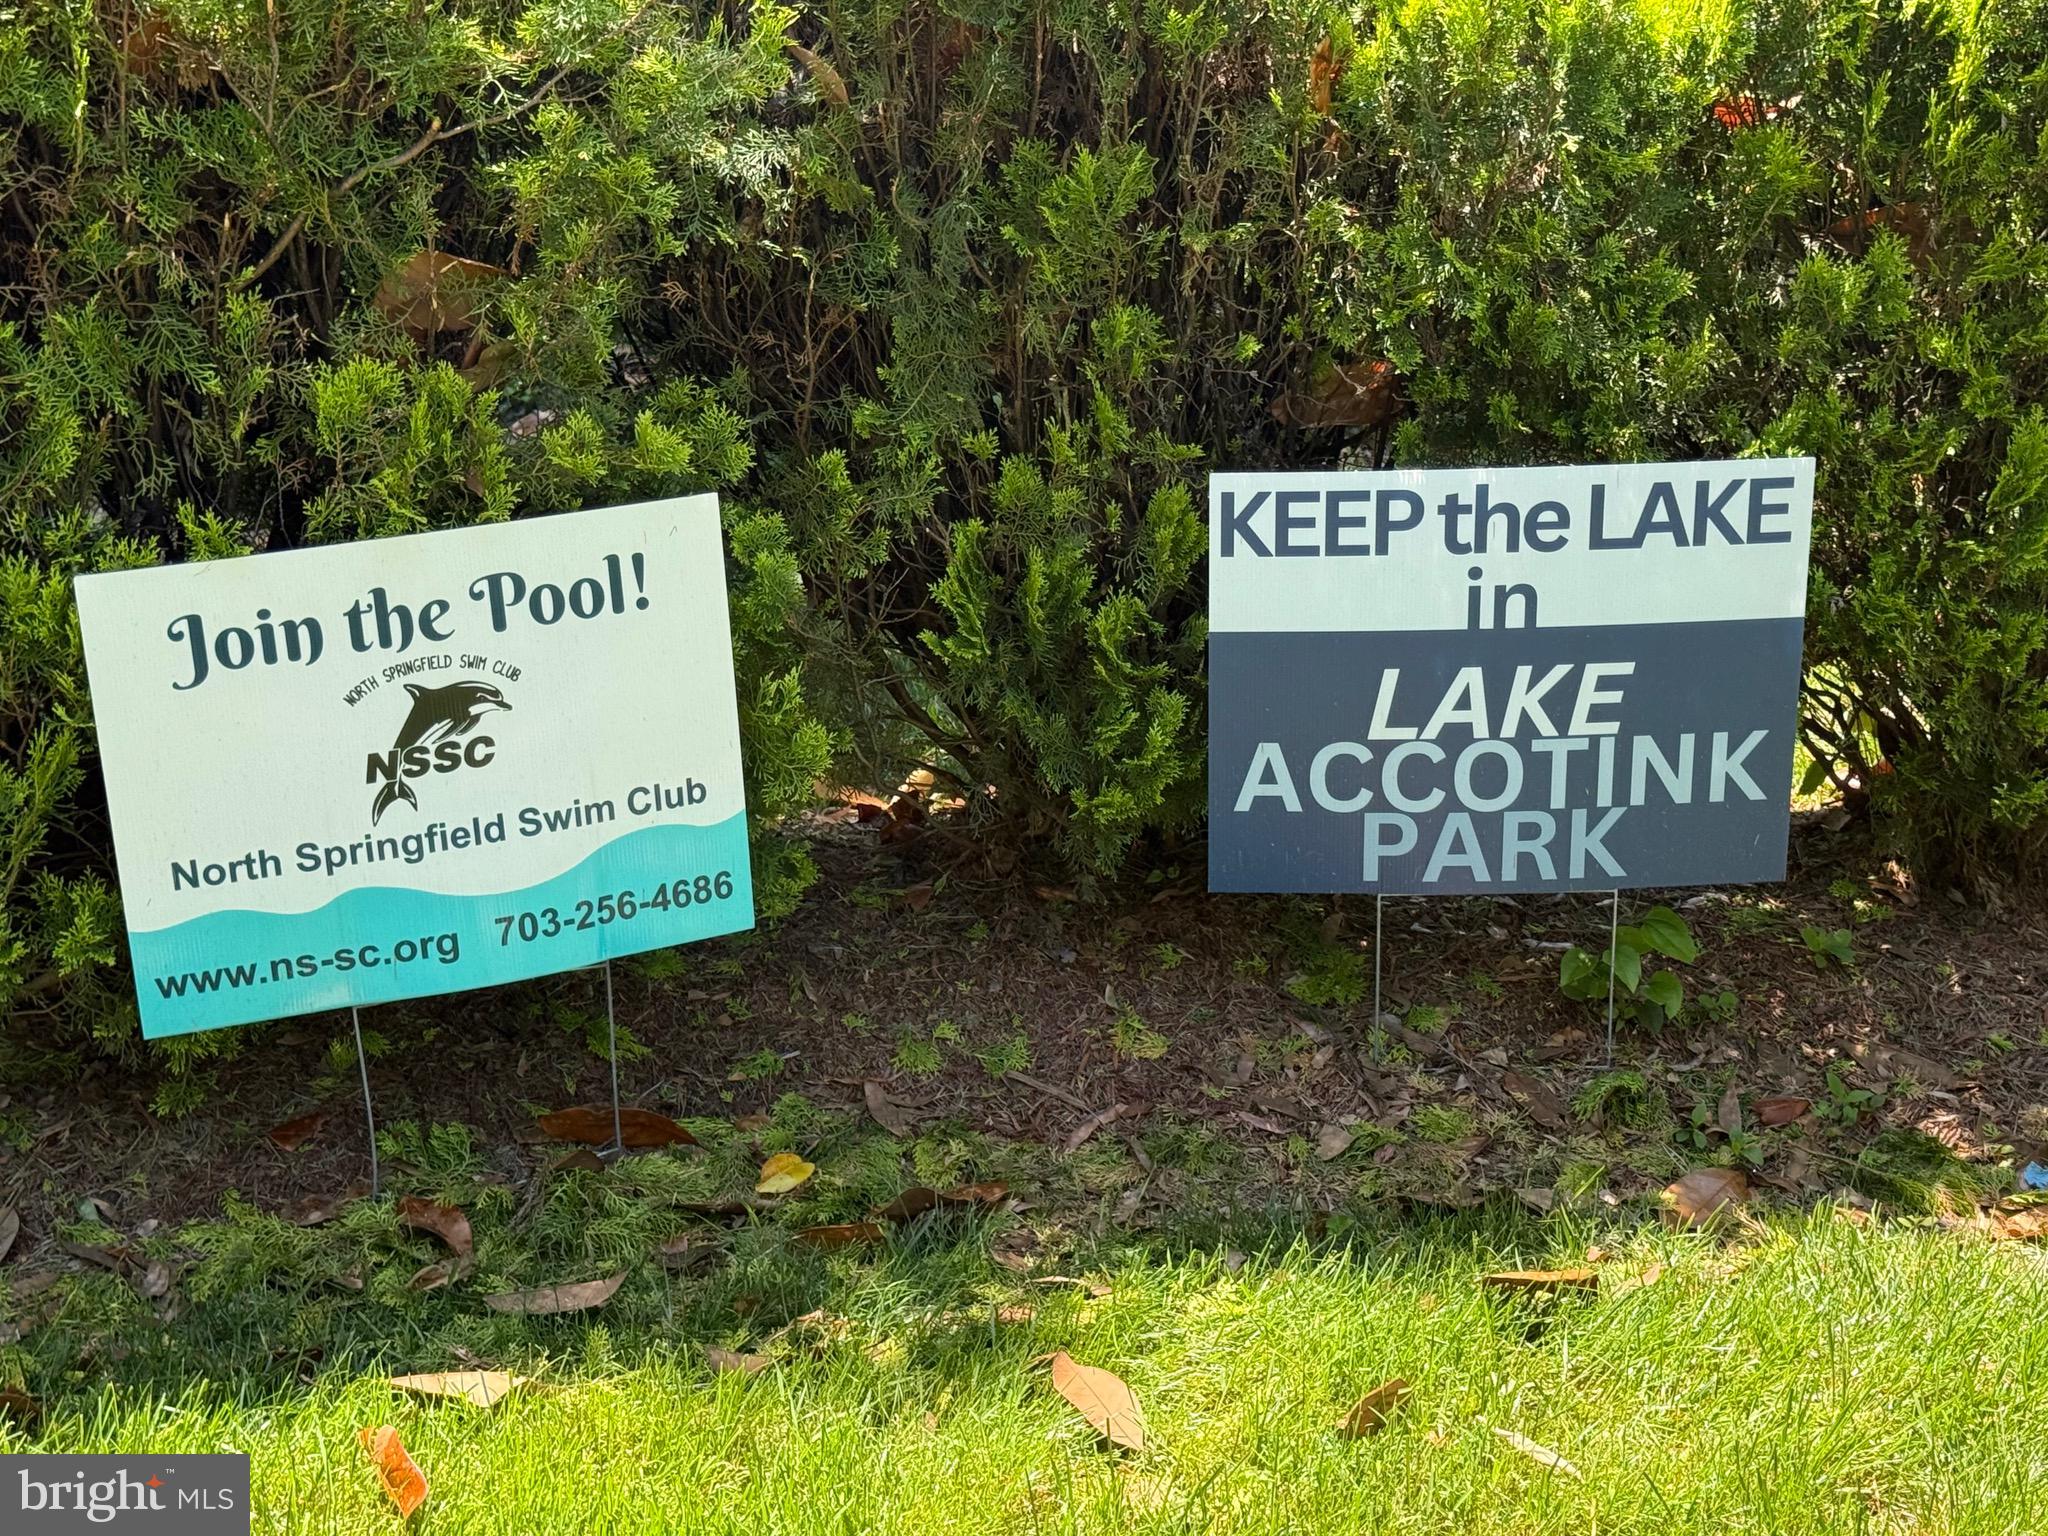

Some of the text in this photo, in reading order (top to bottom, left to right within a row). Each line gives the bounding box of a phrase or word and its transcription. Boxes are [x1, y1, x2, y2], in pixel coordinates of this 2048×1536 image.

[1220, 477, 1795, 557] KEEP the LAKE
[167, 552, 650, 690] Join the Pool!
[1467, 566, 1537, 630] in
[343, 654, 522, 707] NORTH SPRINGFIELD SWIM CLUB
[1367, 661, 1636, 740] LAKE
[366, 736, 495, 784] NSSC
[1234, 729, 1769, 813] ACCOTINK
[171, 778, 707, 891] North Springfield Swim Club
[1363, 807, 1628, 883] PARK
[495, 871, 733, 947] 703-256-4686
[154, 929, 460, 999] www.ns-sc.org
